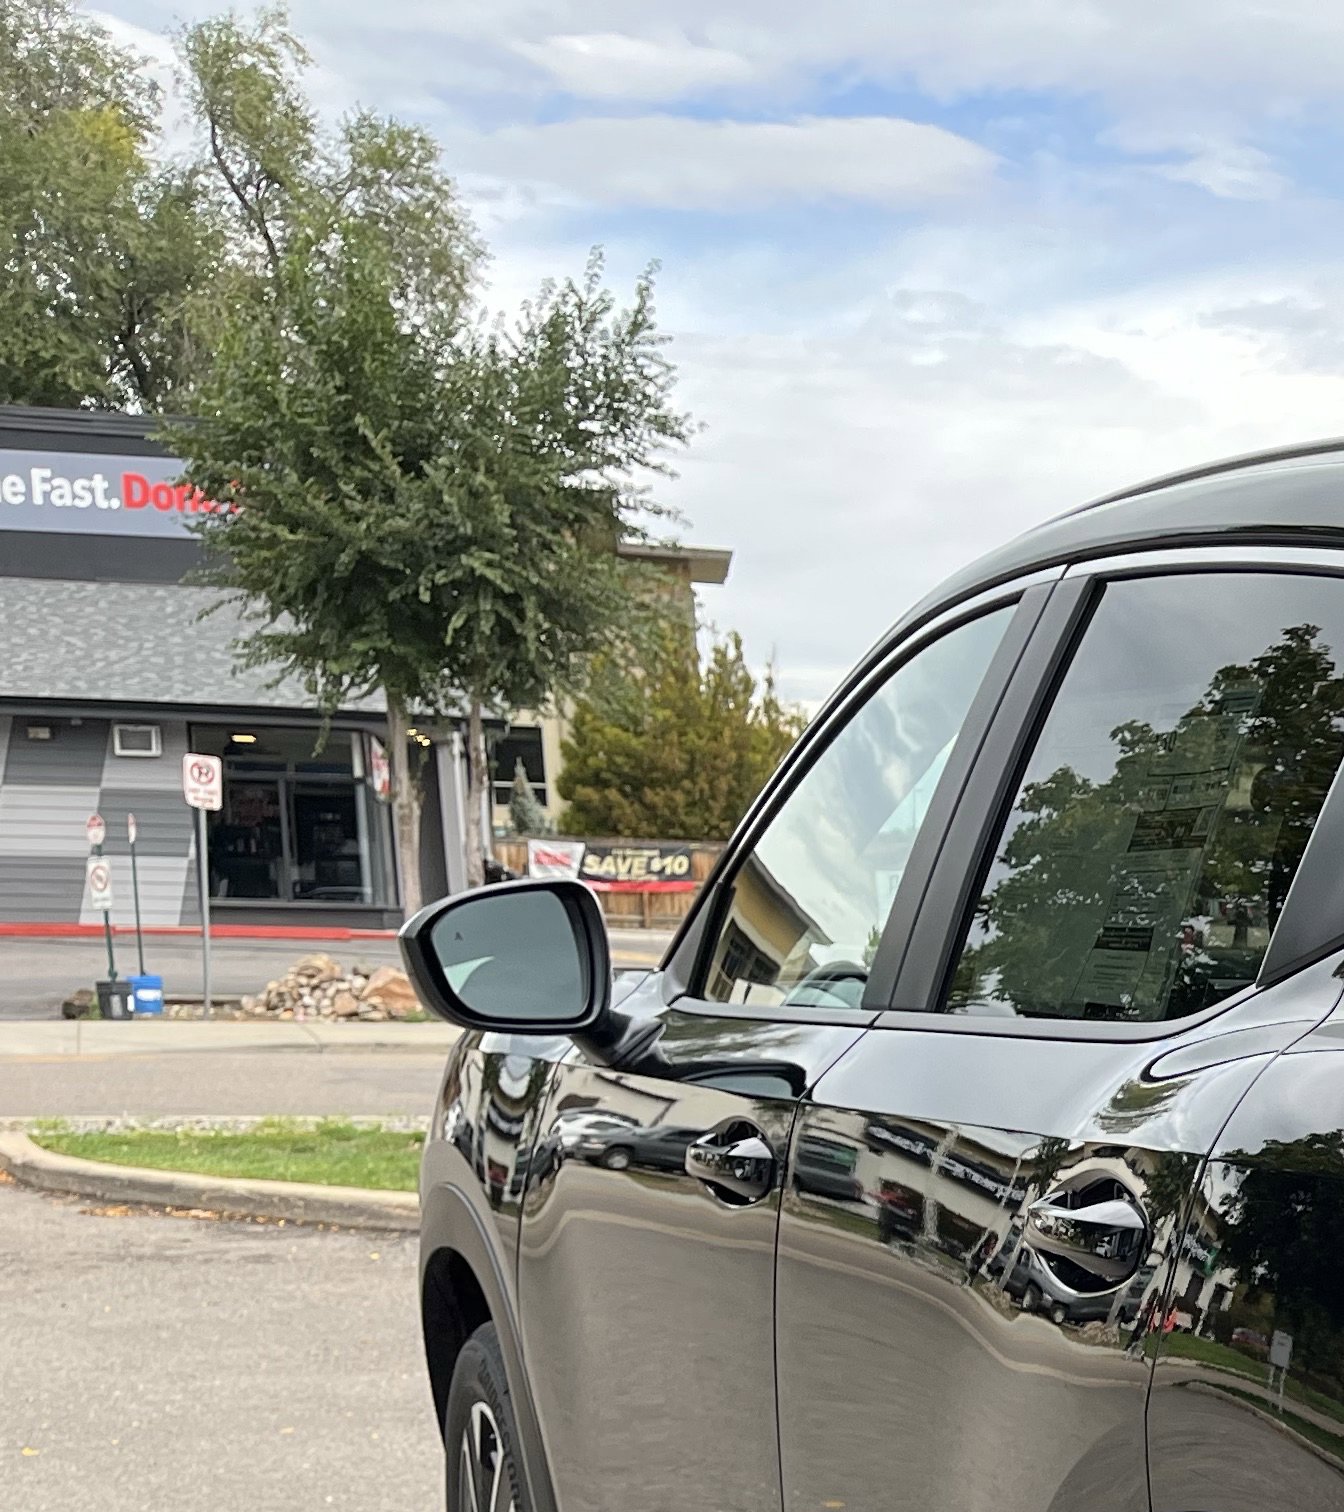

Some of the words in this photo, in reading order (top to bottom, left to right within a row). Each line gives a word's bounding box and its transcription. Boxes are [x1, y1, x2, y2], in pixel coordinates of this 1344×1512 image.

[30, 467, 120, 510] Fast.
[582, 854, 648, 877] SAVE
[650, 854, 690, 877] $10
